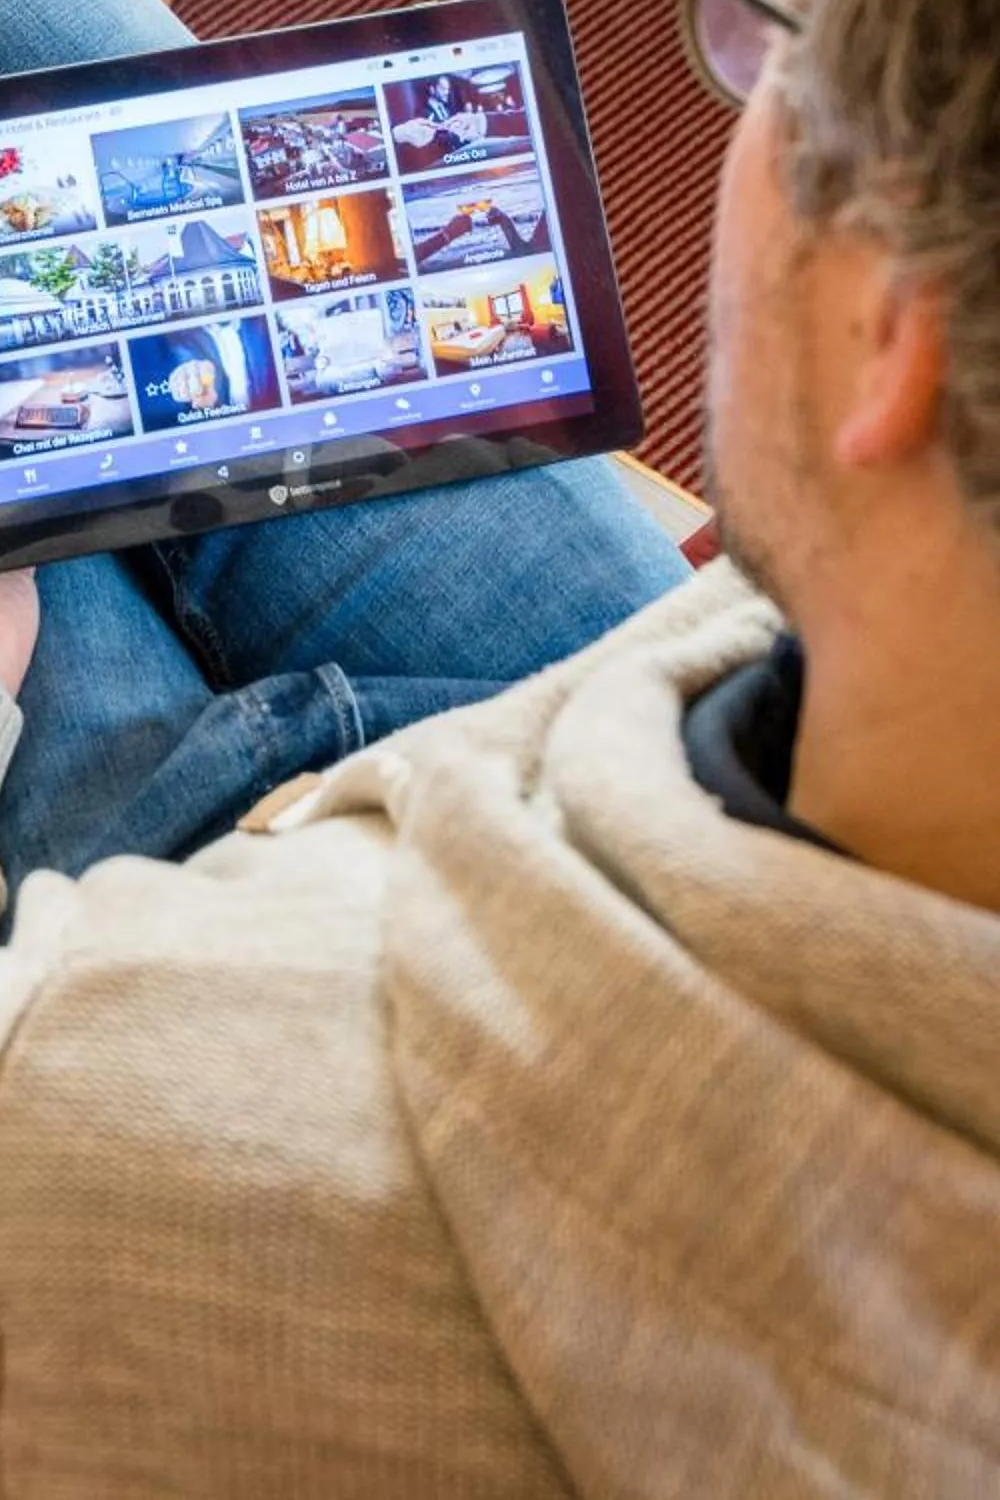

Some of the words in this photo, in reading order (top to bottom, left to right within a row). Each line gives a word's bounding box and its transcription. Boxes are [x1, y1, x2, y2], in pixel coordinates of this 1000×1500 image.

[284, 179, 308, 193] Hotel
[310, 177, 326, 189] von
[177, 408, 204, 424] Quick
